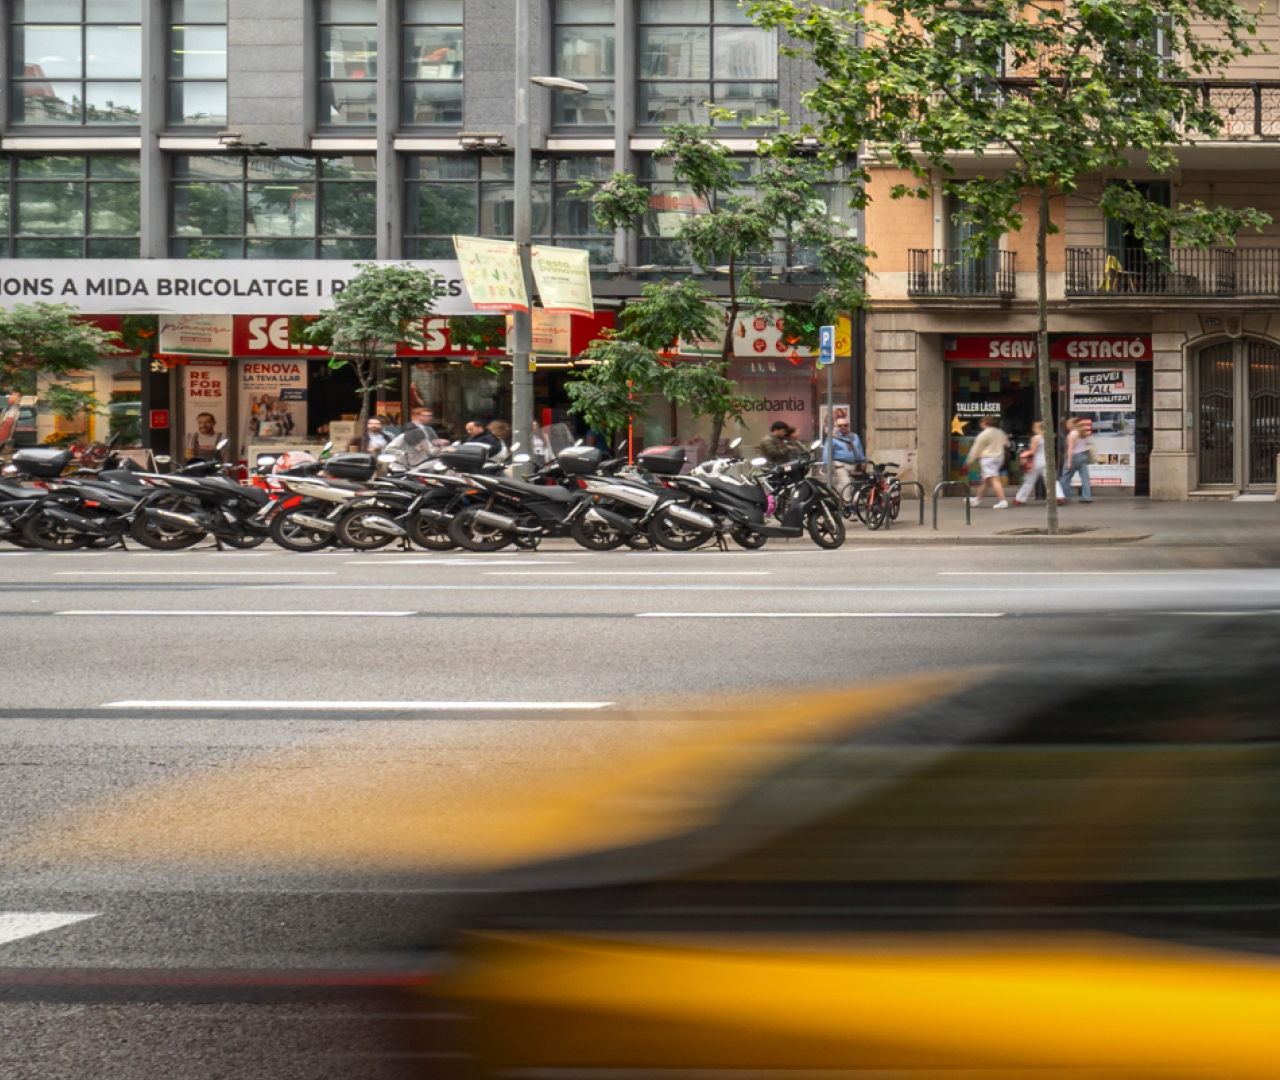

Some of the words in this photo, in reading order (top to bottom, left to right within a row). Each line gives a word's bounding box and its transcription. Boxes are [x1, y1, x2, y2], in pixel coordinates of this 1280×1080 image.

[60, 278, 79, 296] A
[85, 278, 149, 296] MIDA
[156, 278, 309, 297] BRICOLATGE
[317, 279, 323, 297] I
[1066, 337, 1146, 358] ESTACIÓ
[243, 364, 301, 374] RENOVA
[190, 371, 211, 380] RE
[1082, 371, 1121, 384] SERVEI
[190, 380, 222, 389] FOR
[1088, 384, 1113, 394] TALL
[190, 389, 222, 397] MES
[956, 402, 979, 412] TALLER
